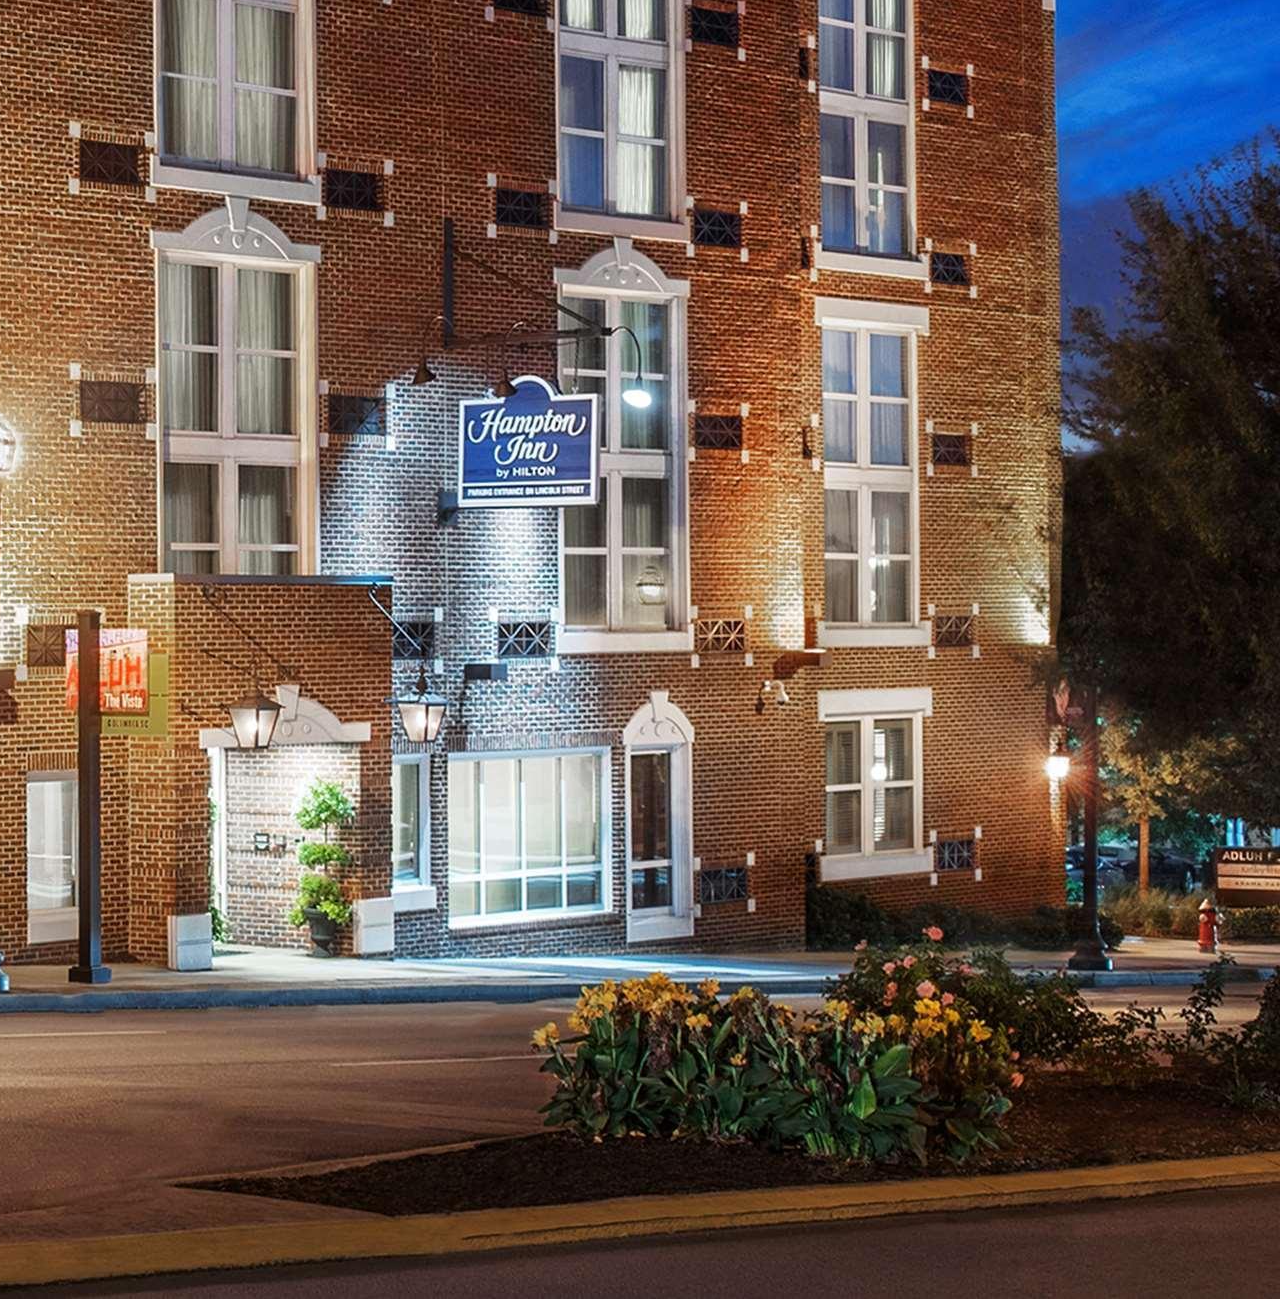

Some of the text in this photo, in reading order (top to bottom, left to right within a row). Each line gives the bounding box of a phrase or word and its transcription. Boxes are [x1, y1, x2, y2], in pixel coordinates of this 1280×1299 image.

[467, 407, 587, 444] Hampton
[494, 435, 559, 465] Inn
[495, 466, 556, 479] by HILTON
[494, 487, 524, 496] ENTRANCE
[562, 485, 585, 494] STREET
[104, 692, 144, 709] The Vista
